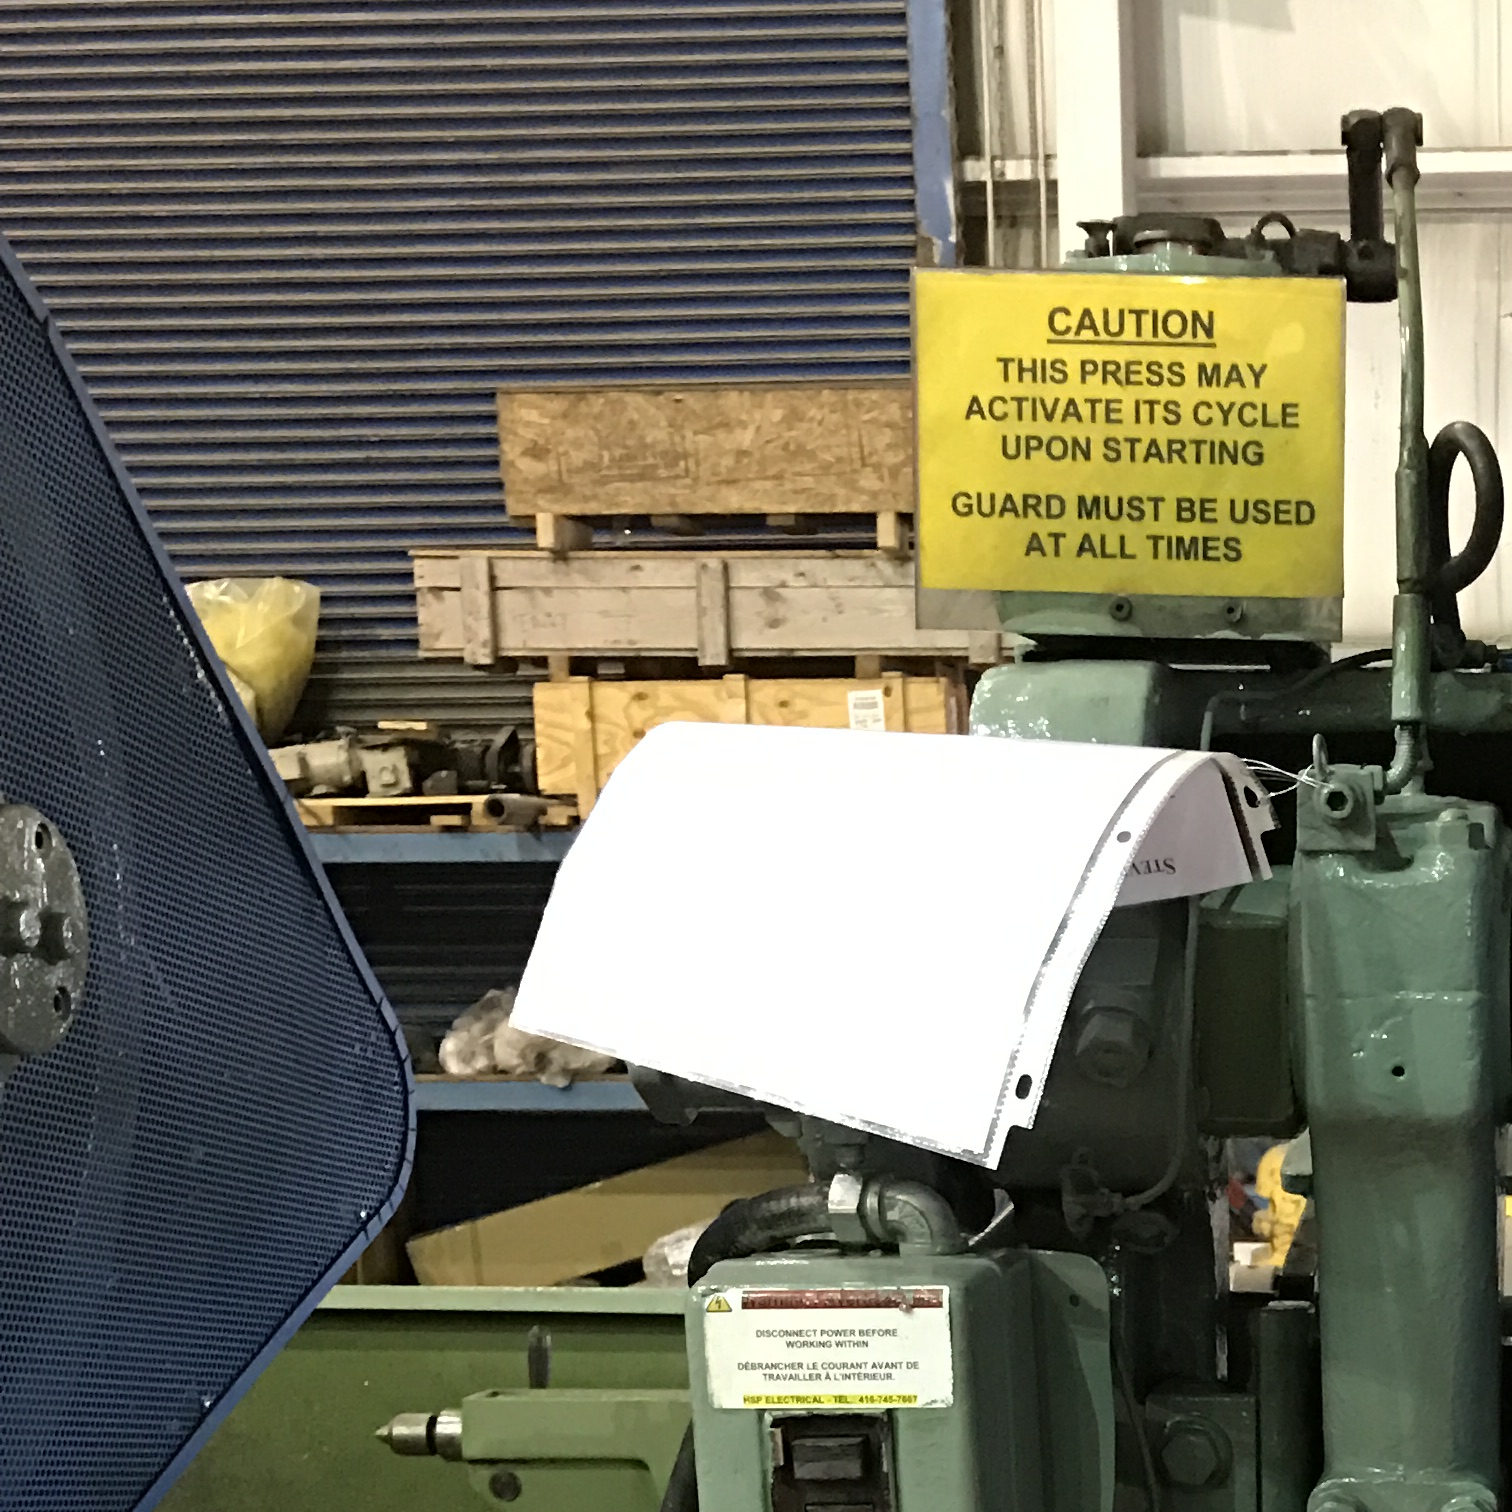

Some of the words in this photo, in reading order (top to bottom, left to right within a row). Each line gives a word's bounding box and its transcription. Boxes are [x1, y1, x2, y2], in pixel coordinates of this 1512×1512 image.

[1047, 306, 1215, 340] CAUTION
[996, 357, 1069, 385] THIS
[1080, 359, 1186, 387] PRESS
[1198, 362, 1267, 388] MAY
[965, 395, 1123, 425] ACTIVATE
[1134, 399, 1182, 426] ITS
[1192, 401, 1300, 428] CYCLE
[1001, 435, 1092, 461] UPON
[1102, 438, 1265, 466] STARTING
[951, 491, 1066, 519] GUARD
[1077, 495, 1166, 522] MUST
[1176, 497, 1218, 523] BE
[1229, 499, 1316, 526] USED
[1024, 532, 1067, 558] AT
[1076, 533, 1137, 560] ALL
[1146, 535, 1242, 562] TIMES
[1127, 858, 1177, 876] STEV
[786, 1340, 832, 1348] WORKING
[835, 1340, 869, 1348] WITHIN
[820, 1329, 856, 1337] POWER
[859, 1329, 898, 1337] BEFORE
[737, 1360, 804, 1371] DÉBRANCHER
[807, 1362, 819, 1370] LE
[821, 1362, 868, 1370] COURANT
[871, 1362, 903, 1370] AVANT
[906, 1361, 919, 1370] DE
[762, 1373, 822, 1381] TRAVAILLER
[765, 1395, 824, 1404] ELECTRICAL
